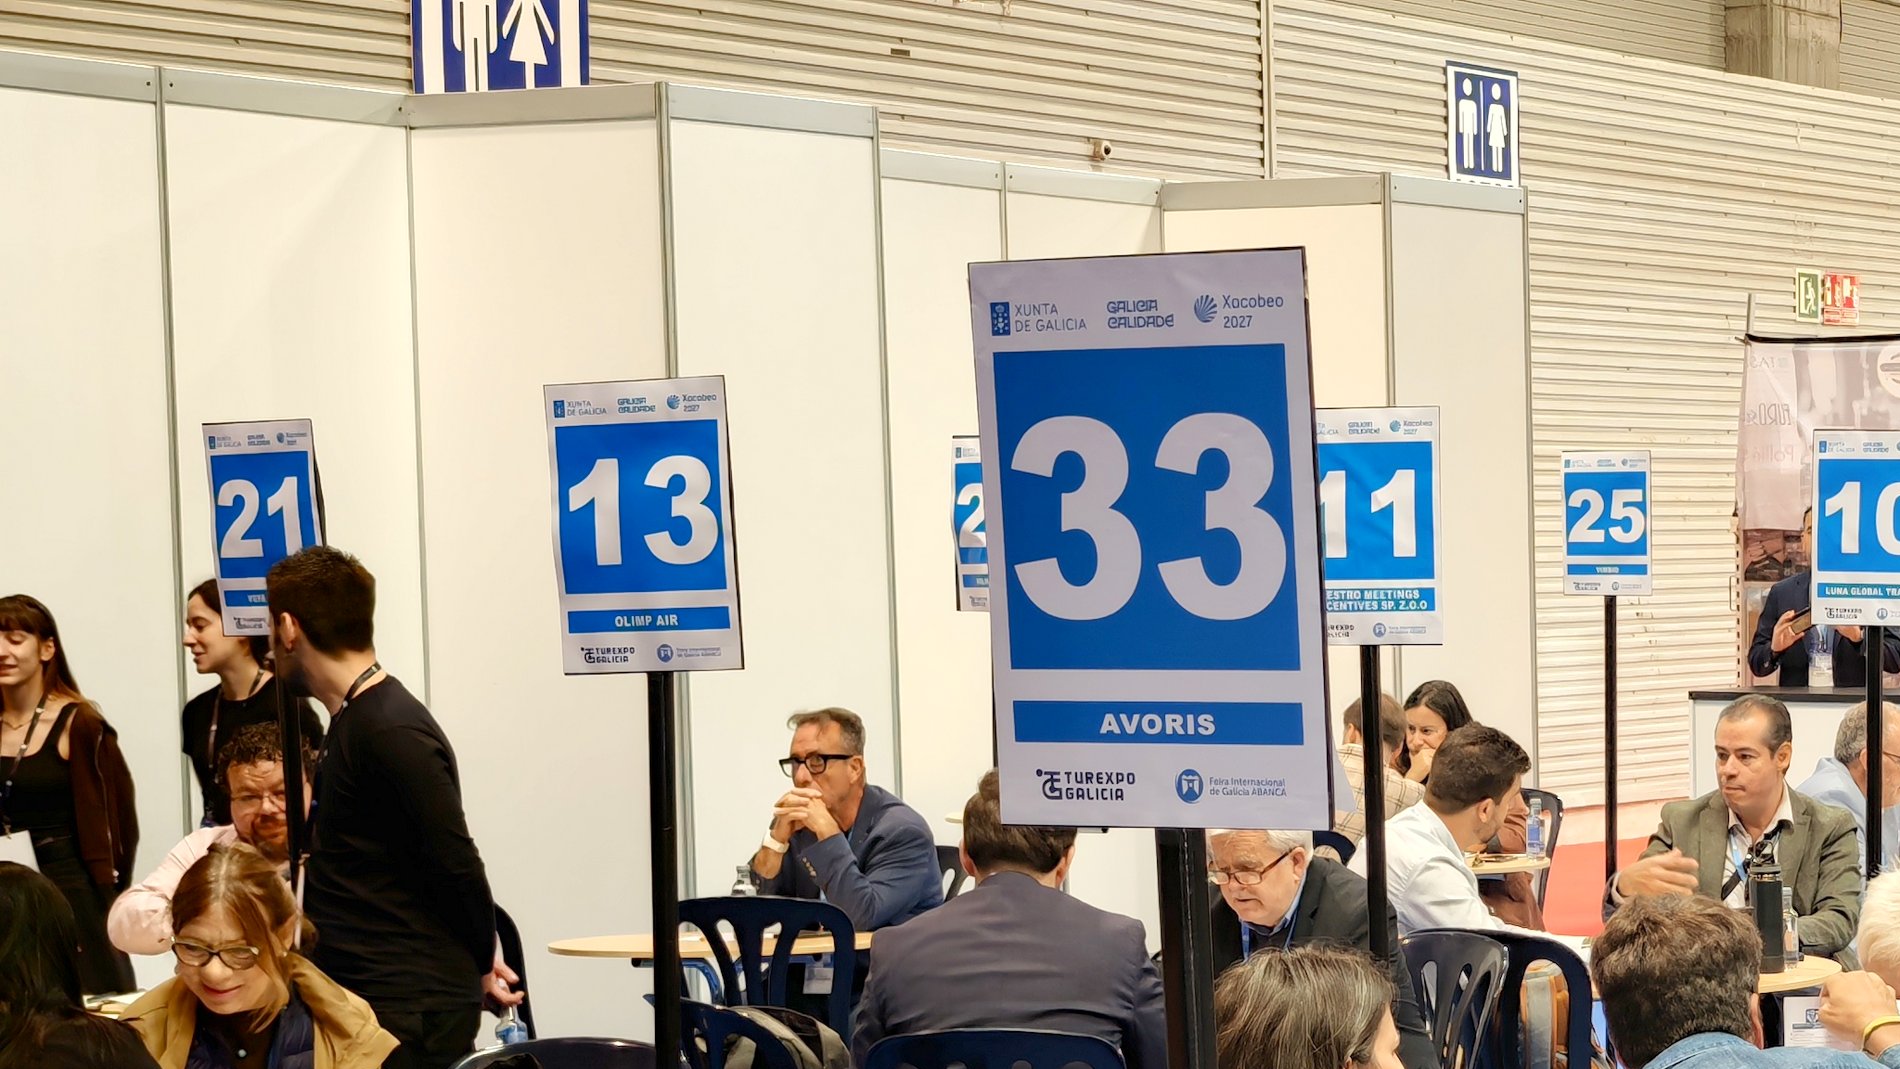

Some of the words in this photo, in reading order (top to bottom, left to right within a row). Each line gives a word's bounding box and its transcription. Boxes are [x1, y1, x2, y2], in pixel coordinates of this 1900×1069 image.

[1107, 300, 1159, 313] GALICIA
[1223, 294, 1285, 309] Xacobeo
[1015, 303, 1059, 316] XUNTA
[1015, 319, 1031, 332] DE
[1035, 318, 1088, 332] GALICIA
[1223, 315, 1253, 329] 2027
[569, 455, 718, 566] 13
[1011, 412, 1287, 621] 33
[1320, 468, 1416, 558] 11
[1568, 488, 1645, 543] 25
[217, 476, 304, 560] 21
[1326, 590, 1361, 600] ESTRO
[1364, 589, 1420, 600] MEETINGS
[1825, 587, 1848, 595] LUNA
[1851, 587, 1883, 596] GLOBAL
[1326, 600, 1379, 611] CENTIVES
[1381, 600, 1396, 610] SP.
[615, 615, 652, 628] OLIMP
[656, 614, 679, 626] AIR
[596, 647, 635, 655] TUREXPO
[596, 655, 629, 663] GALICIA
[1100, 713, 1216, 736] AVORIS
[1065, 772, 1136, 785] TUREXPO
[1066, 788, 1124, 801] GALICIA
[1209, 787, 1220, 796] de
